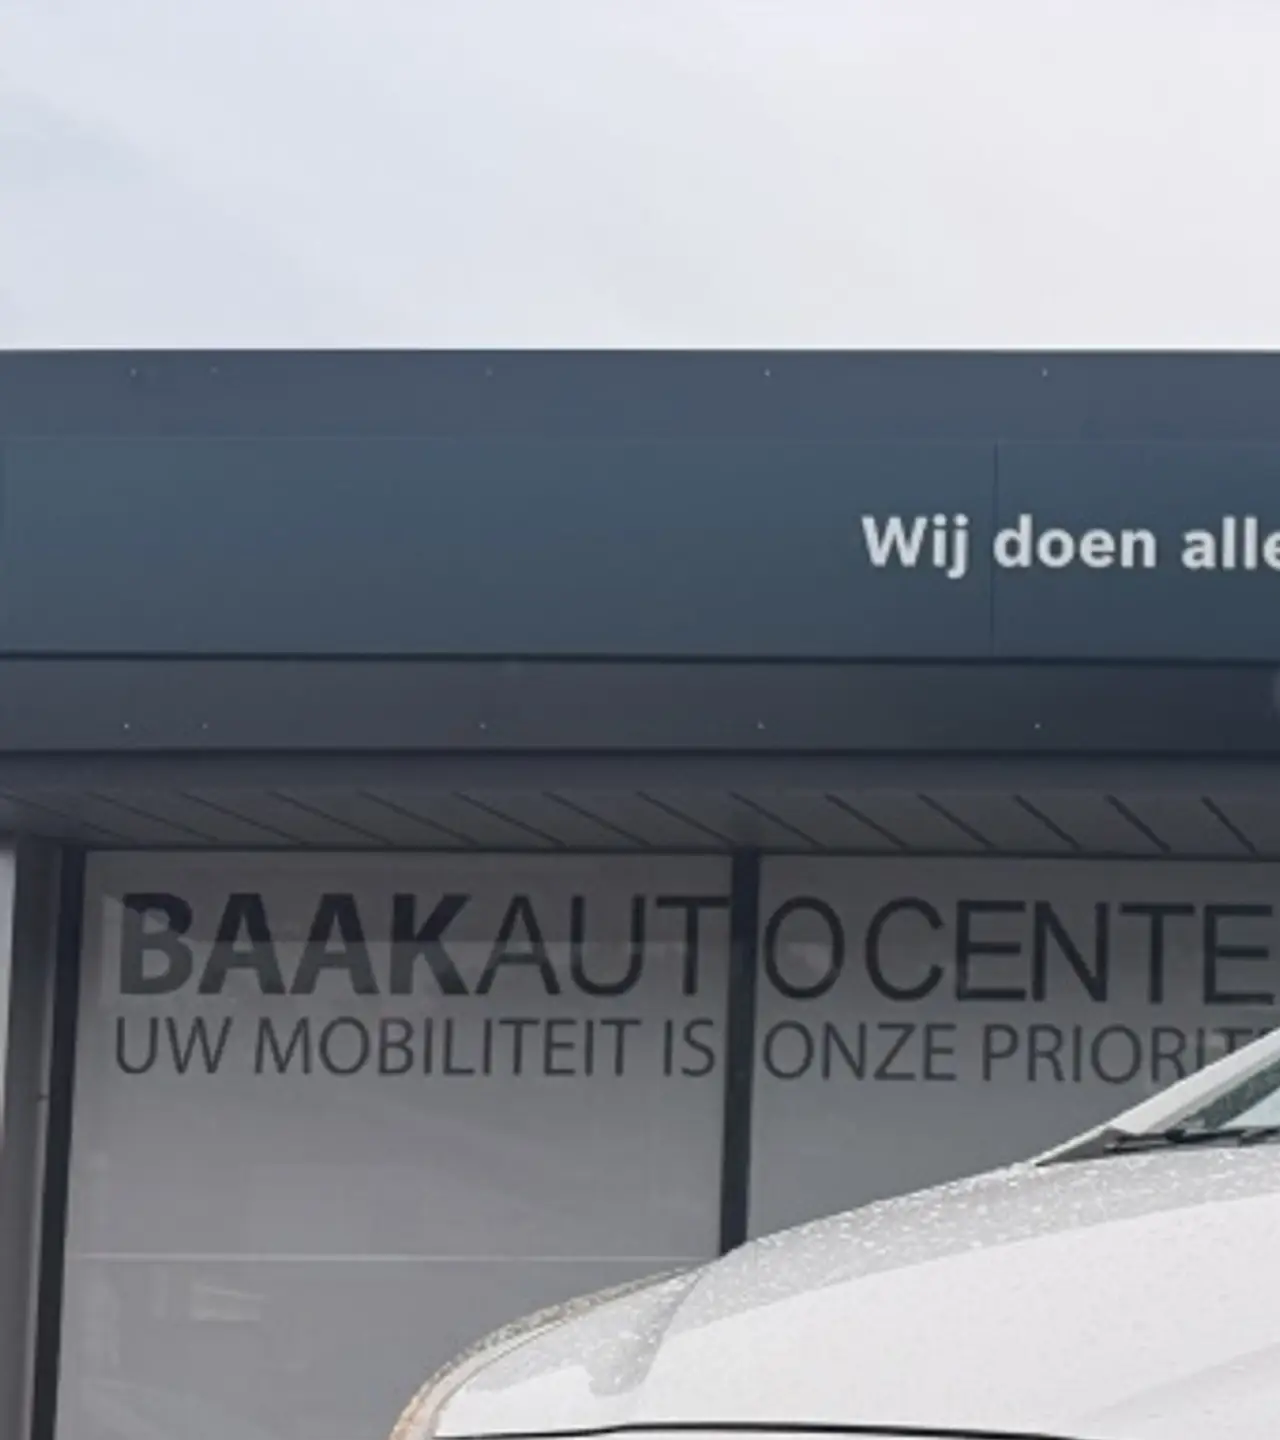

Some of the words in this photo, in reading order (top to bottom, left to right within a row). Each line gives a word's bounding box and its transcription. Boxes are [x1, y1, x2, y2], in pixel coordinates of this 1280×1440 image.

[861, 513, 970, 579] Wij
[992, 513, 1157, 569] doen
[114, 1016, 233, 1075] UW
[254, 1016, 643, 1077] MOBILITEIT
[663, 1017, 716, 1077] IS
[762, 1020, 958, 1082] ONZE
[981, 1023, 1278, 1084] PRIORIT
